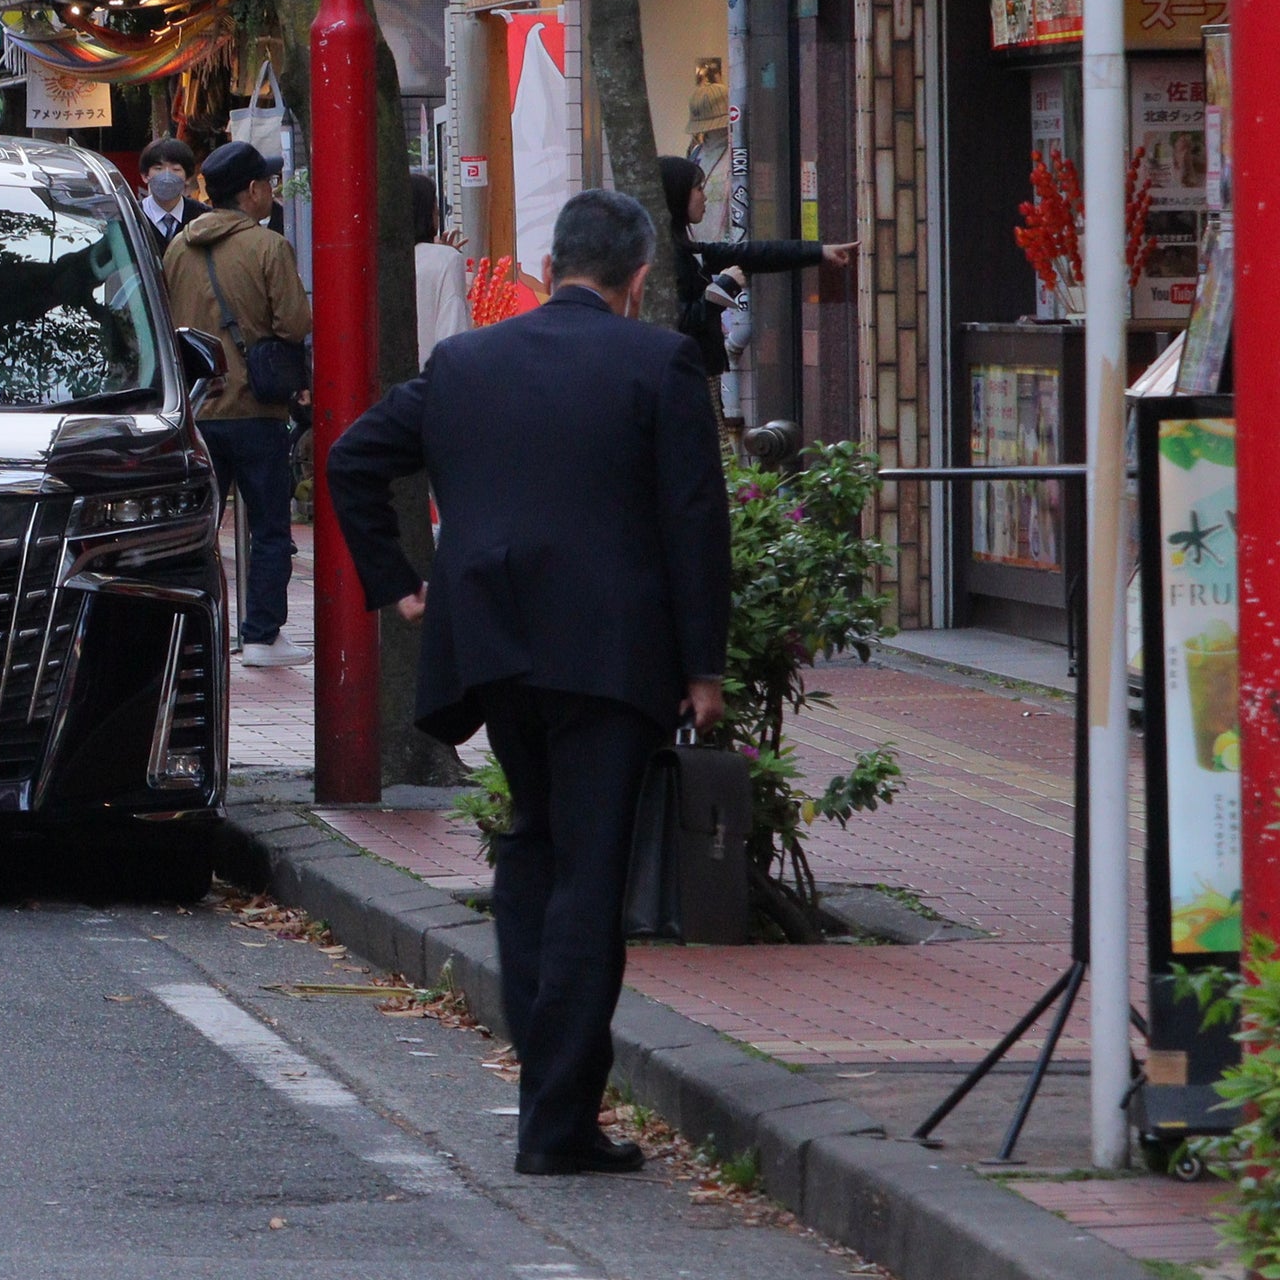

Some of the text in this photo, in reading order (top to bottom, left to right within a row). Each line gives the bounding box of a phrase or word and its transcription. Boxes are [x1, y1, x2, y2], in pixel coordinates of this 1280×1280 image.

[31, 107, 107, 121] アメツチテラス
